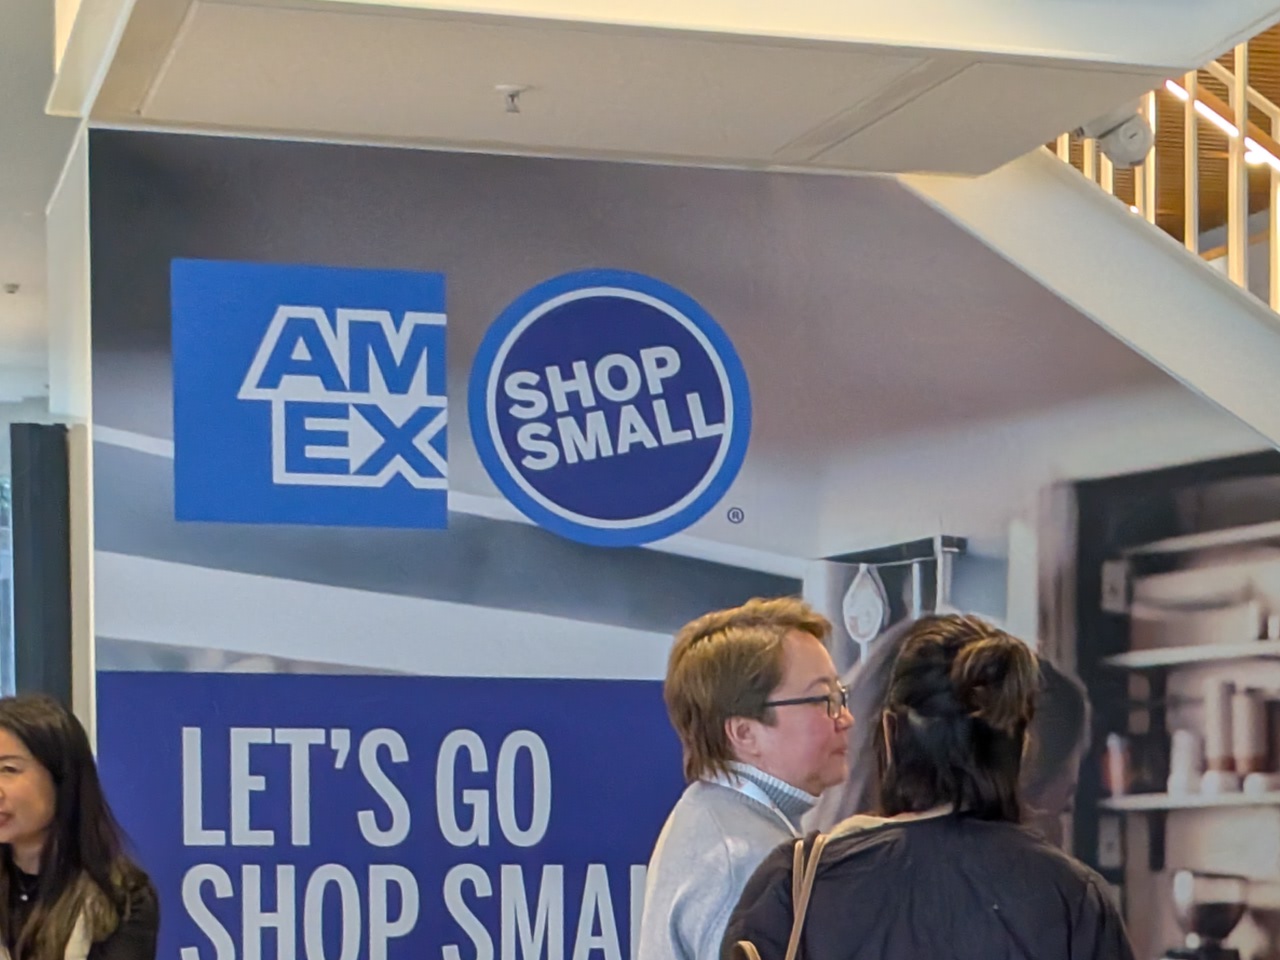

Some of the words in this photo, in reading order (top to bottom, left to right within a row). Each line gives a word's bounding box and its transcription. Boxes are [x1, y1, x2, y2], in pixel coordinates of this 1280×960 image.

[505, 346, 682, 420] SHOP
[516, 393, 725, 471] SMALL
[181, 726, 412, 848] LET’S
[435, 728, 552, 848] GO
